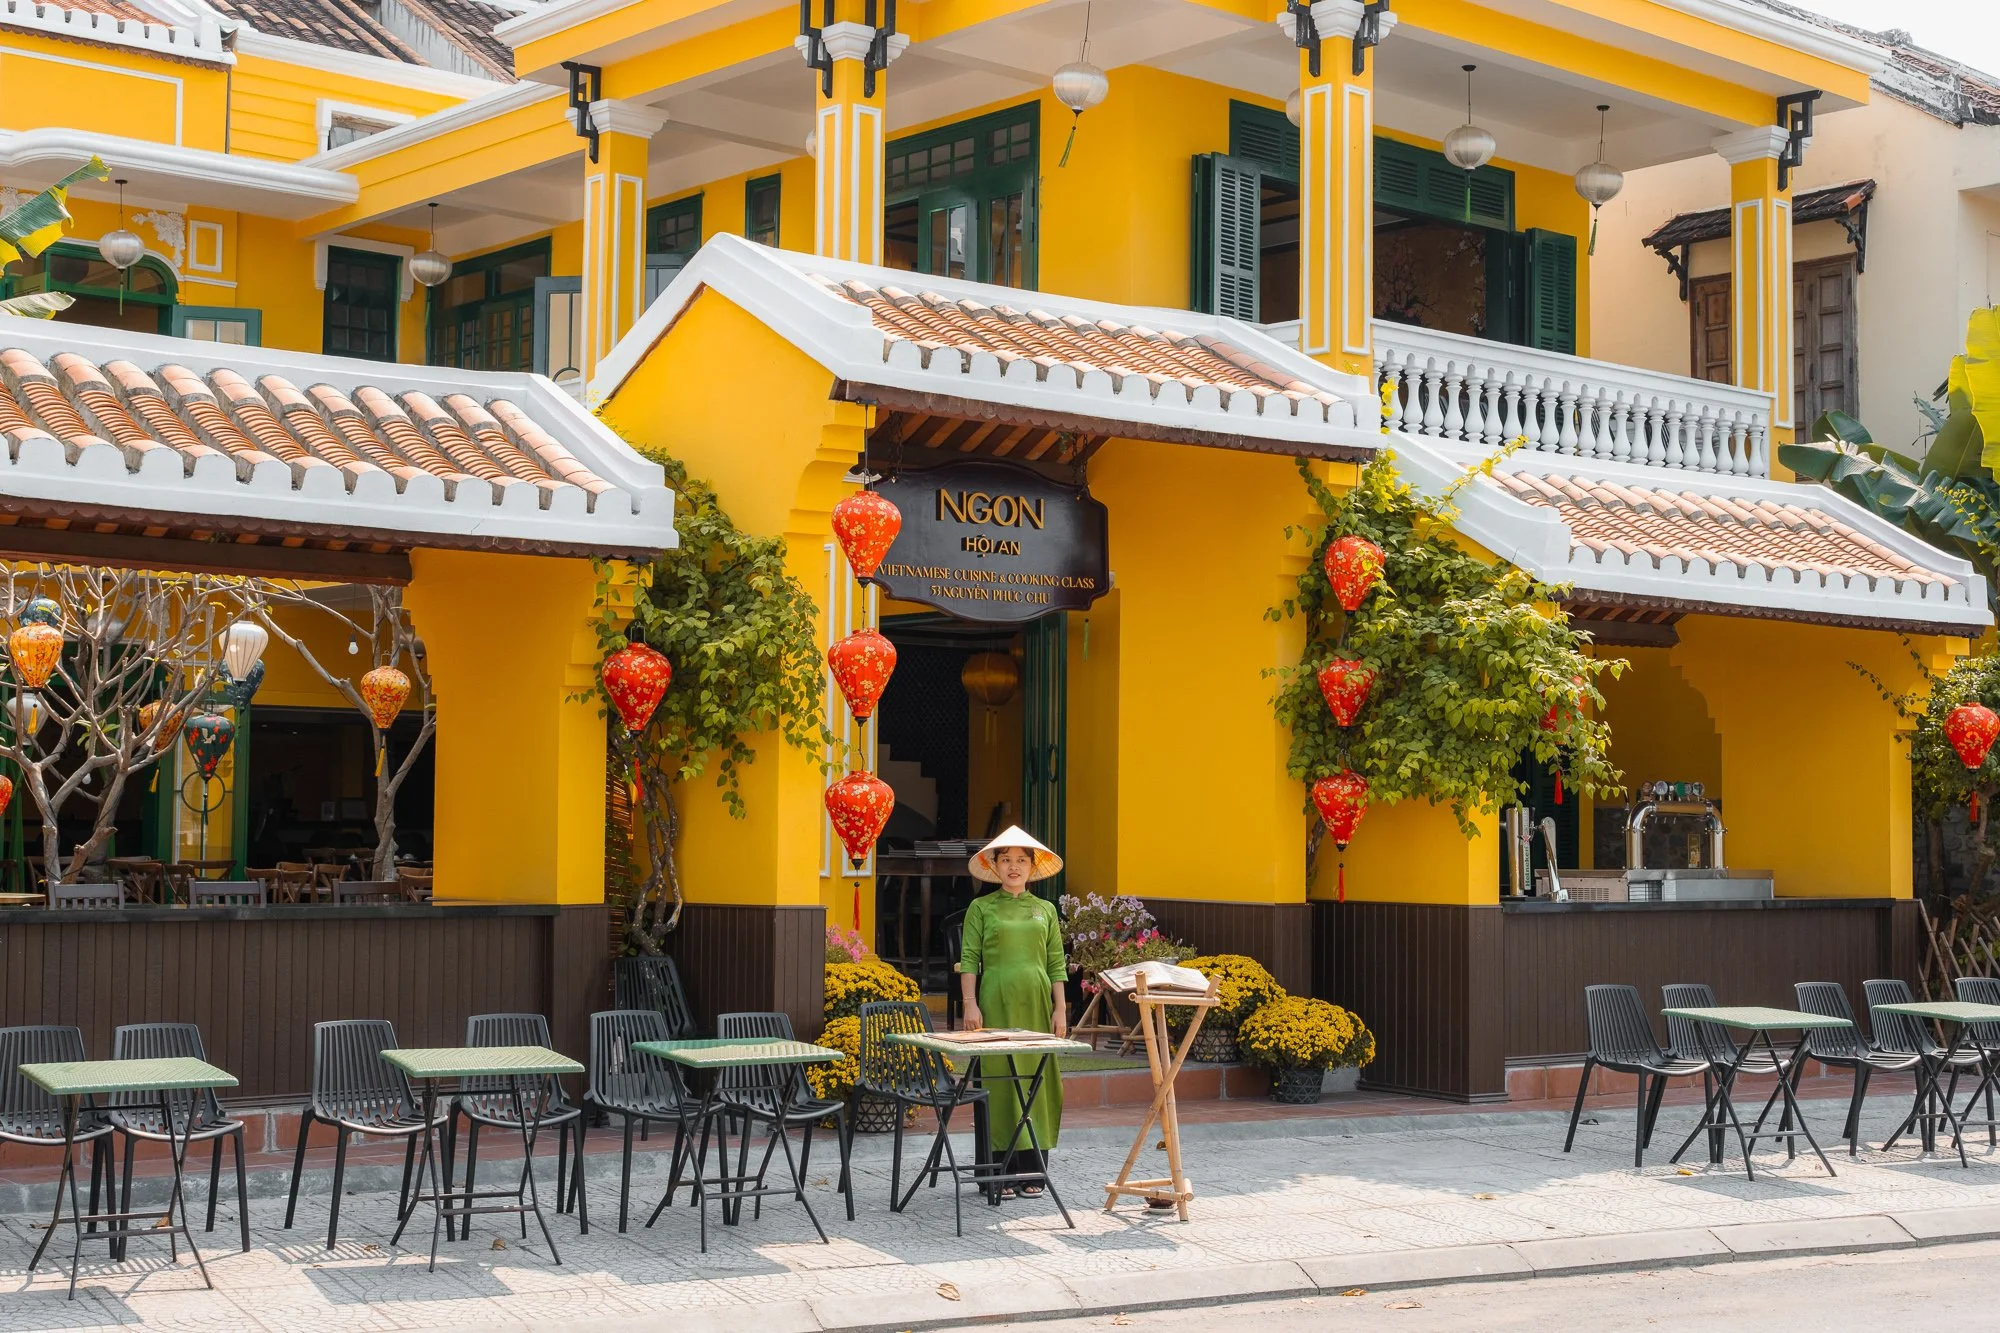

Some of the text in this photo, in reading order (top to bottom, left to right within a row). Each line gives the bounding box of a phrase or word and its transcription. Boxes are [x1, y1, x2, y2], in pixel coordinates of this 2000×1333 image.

[939, 488, 1045, 529] NGON
[965, 534, 1021, 558] HỘI AN
[879, 563, 1095, 589] VIETNAMESE CUISINE & COOKING CLASS
[930, 585, 941, 596] 53
